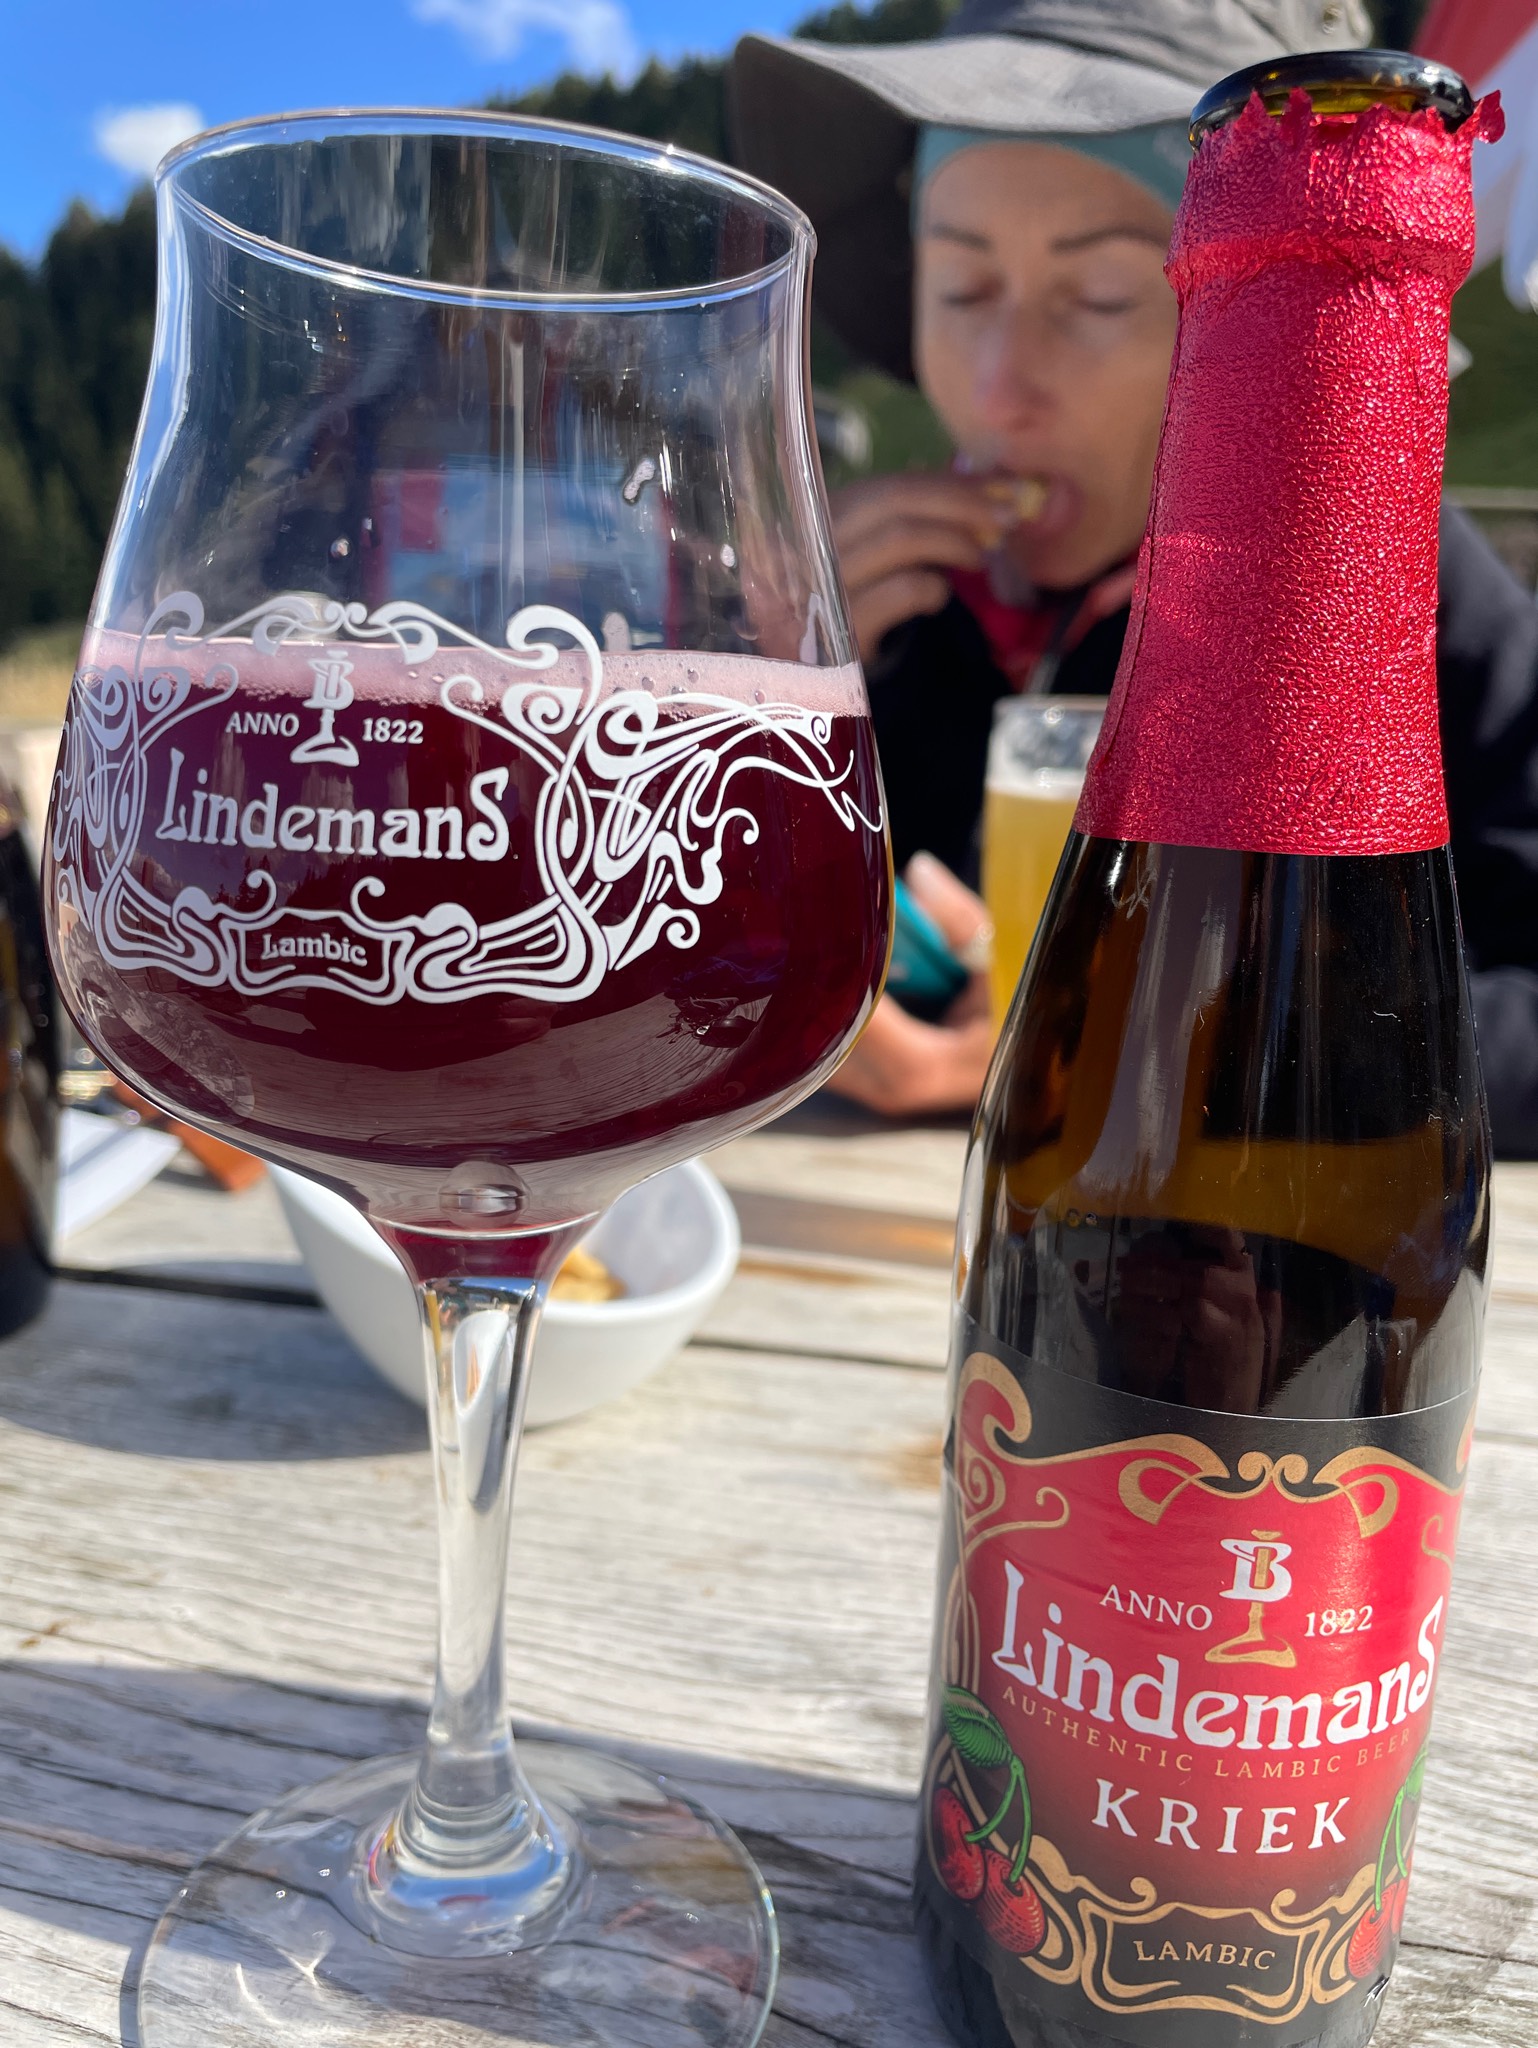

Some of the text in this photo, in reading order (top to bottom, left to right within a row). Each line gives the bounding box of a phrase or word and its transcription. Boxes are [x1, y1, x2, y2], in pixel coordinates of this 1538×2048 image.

[225, 711, 424, 746] ANNO 1822
[260, 931, 368, 969] Lambic
[1098, 1584, 1373, 1638] ANNO 1822
[1001, 1684, 1410, 1779] AUTHENTIC LAMBIC BEER
[1091, 1779, 1352, 1854] KRIEK
[1132, 1939, 1277, 1971] LAMBIC
